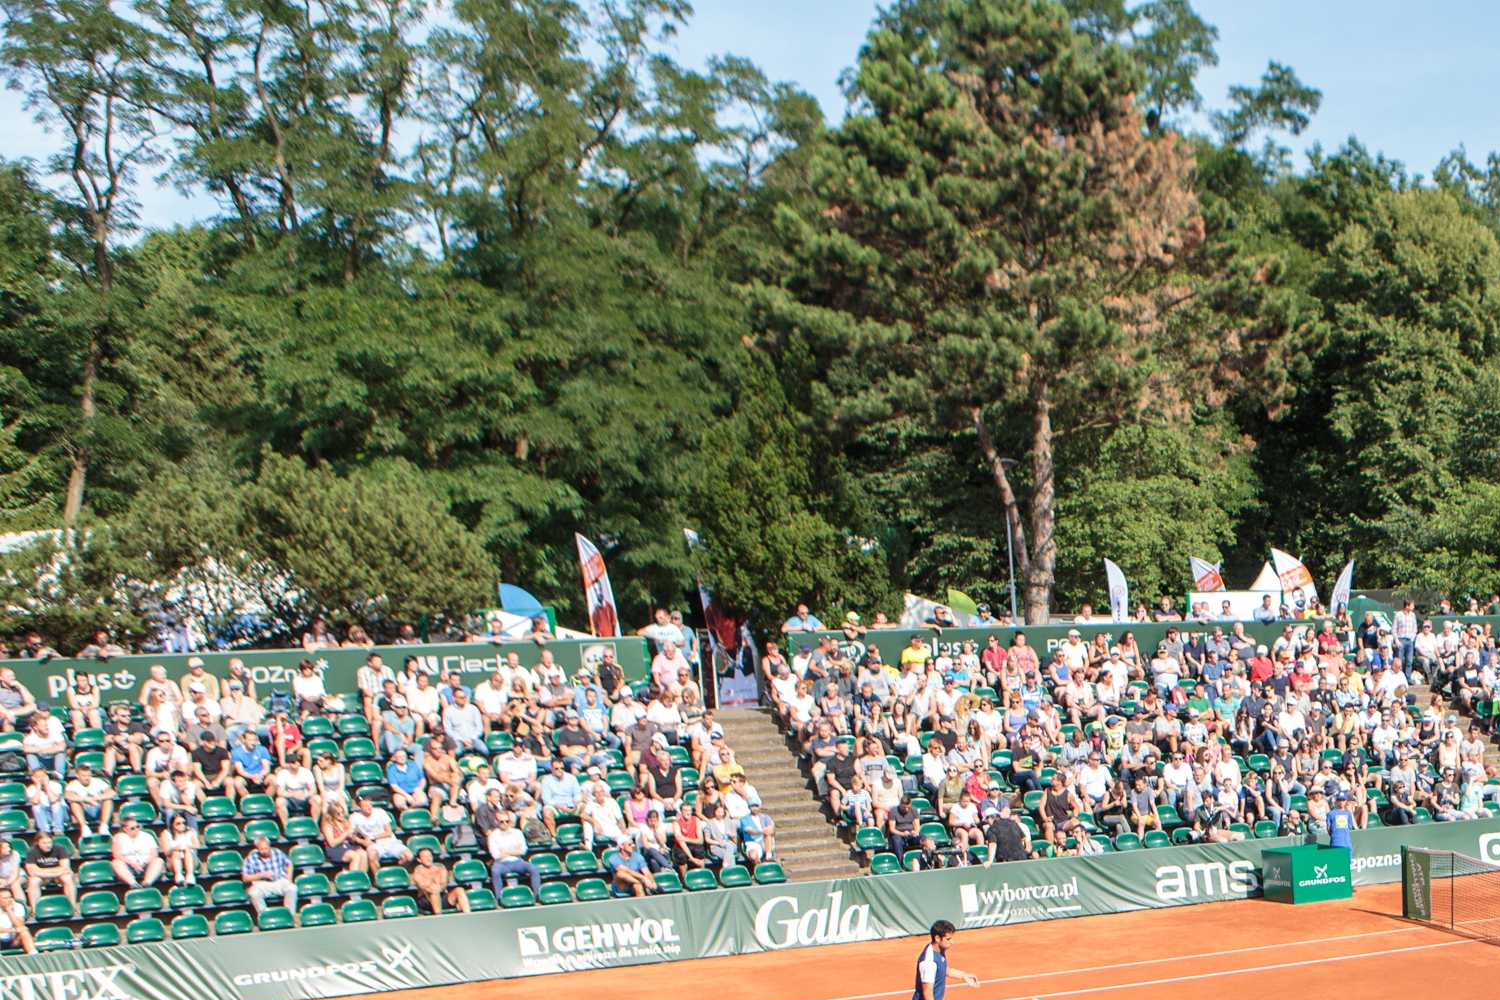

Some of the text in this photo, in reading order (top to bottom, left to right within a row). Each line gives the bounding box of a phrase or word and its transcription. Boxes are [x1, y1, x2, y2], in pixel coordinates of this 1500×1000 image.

[979, 876, 1080, 907] wyborcza.pl
[1155, 860, 1259, 900] ams
[1298, 875, 1346, 887] GRUNDFOS
[551, 917, 681, 952] GEHWOL
[754, 890, 874, 950] Gala
